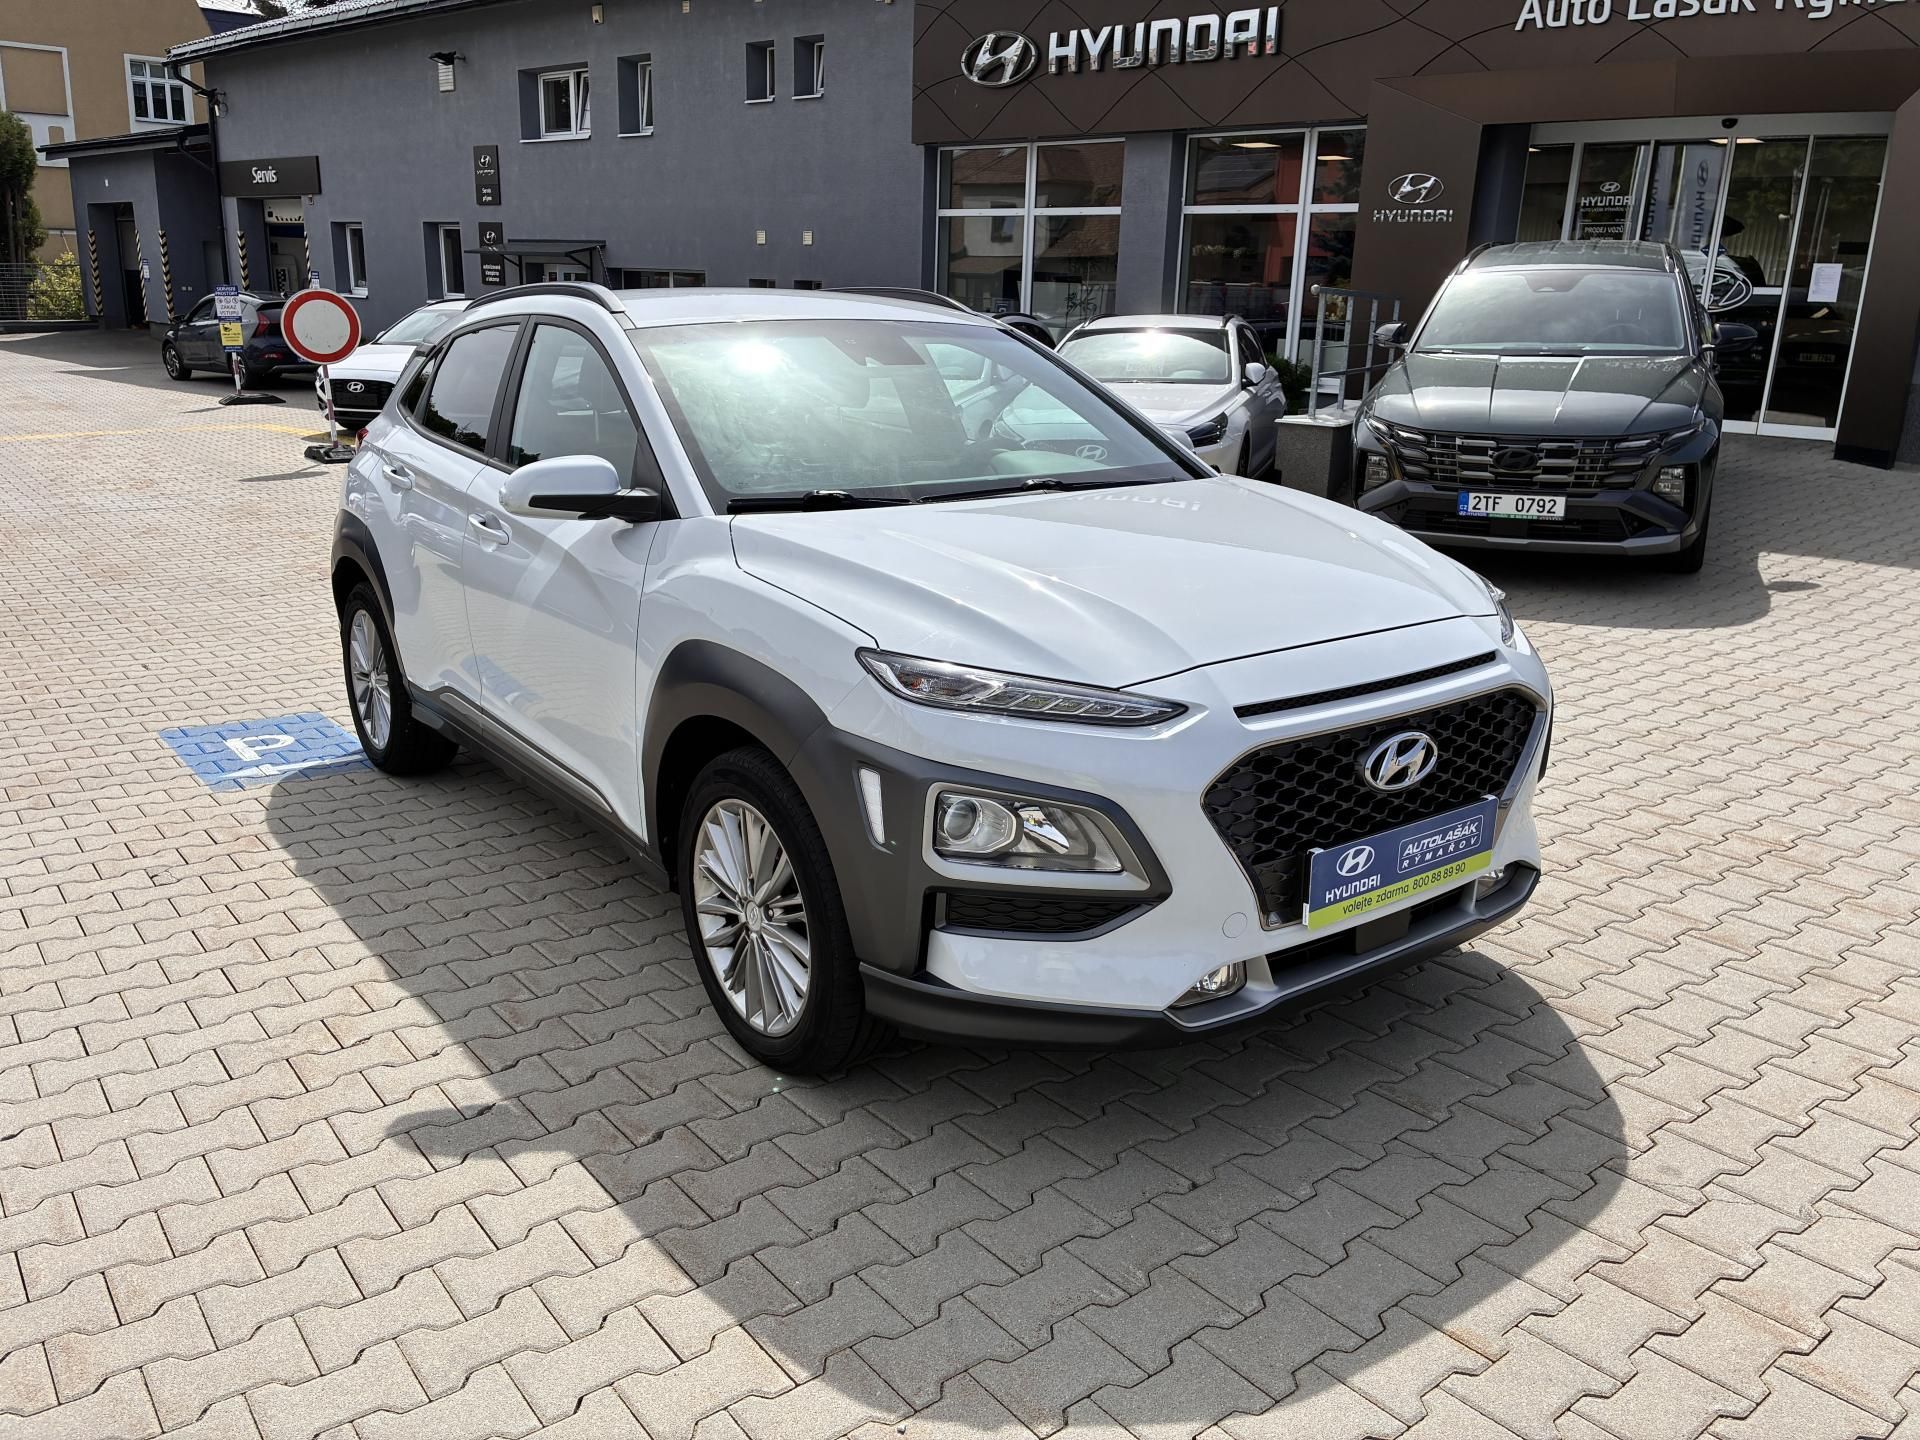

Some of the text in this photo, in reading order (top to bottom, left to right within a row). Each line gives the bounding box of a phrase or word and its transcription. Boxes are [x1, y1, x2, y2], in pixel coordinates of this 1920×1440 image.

[1048, 6, 1279, 74] HYUNDAI
[251, 165, 278, 184] Servis
[1372, 209, 1454, 223] HYUNDAI
[1472, 495, 1557, 514] 2TF 0792
[1401, 836, 1478, 869] RÝMAŘOV
[1402, 821, 1479, 857] AUTOLAŠÁK
[1325, 873, 1381, 903] HYUNDAI
[1342, 861, 1467, 914] volejte zdarma 800 88 89 90
